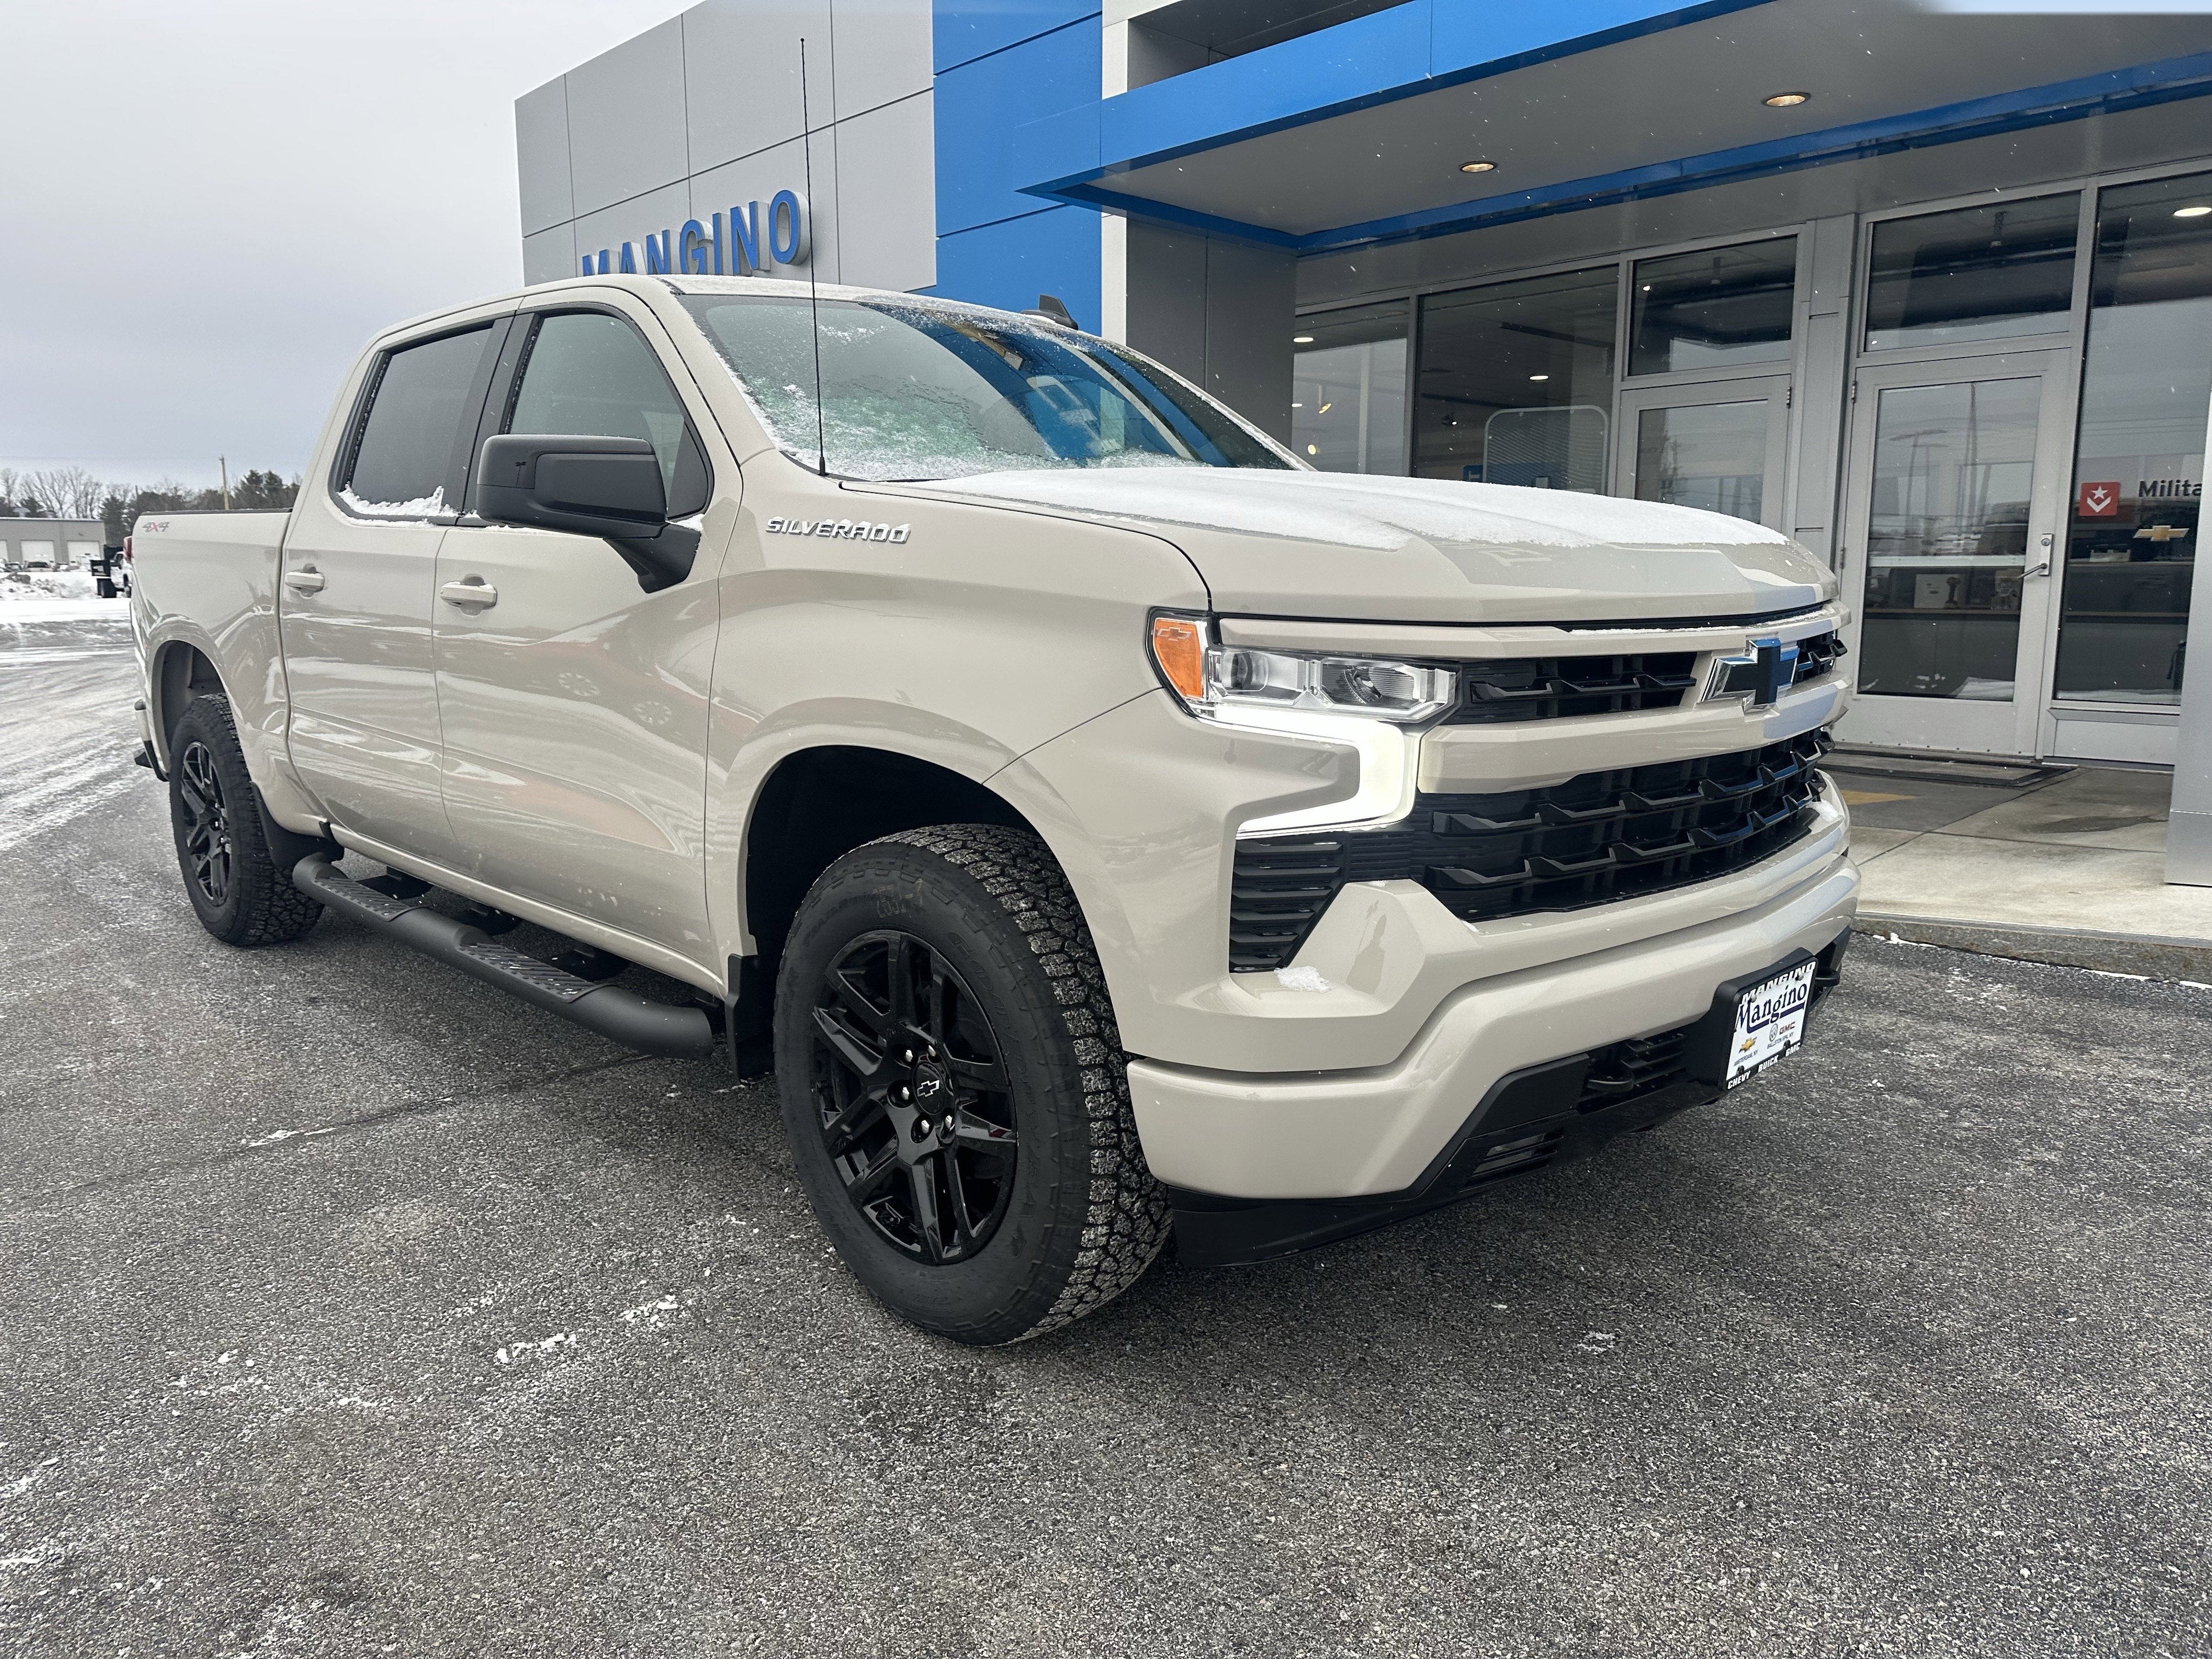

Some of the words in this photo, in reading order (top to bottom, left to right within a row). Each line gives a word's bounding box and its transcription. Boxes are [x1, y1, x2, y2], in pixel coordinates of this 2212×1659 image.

[2138, 479, 2202, 498] Milita
[766, 517, 912, 544] SILVERADO
[1741, 961, 1816, 1005] MANGINO
[1735, 984, 1807, 1032] Mangino
[1779, 1021, 1796, 1035] GMC
[1728, 1070, 1751, 1090] CHEVY
[1758, 1054, 1779, 1073] BUICK
[1785, 1042, 1801, 1057] GMC
